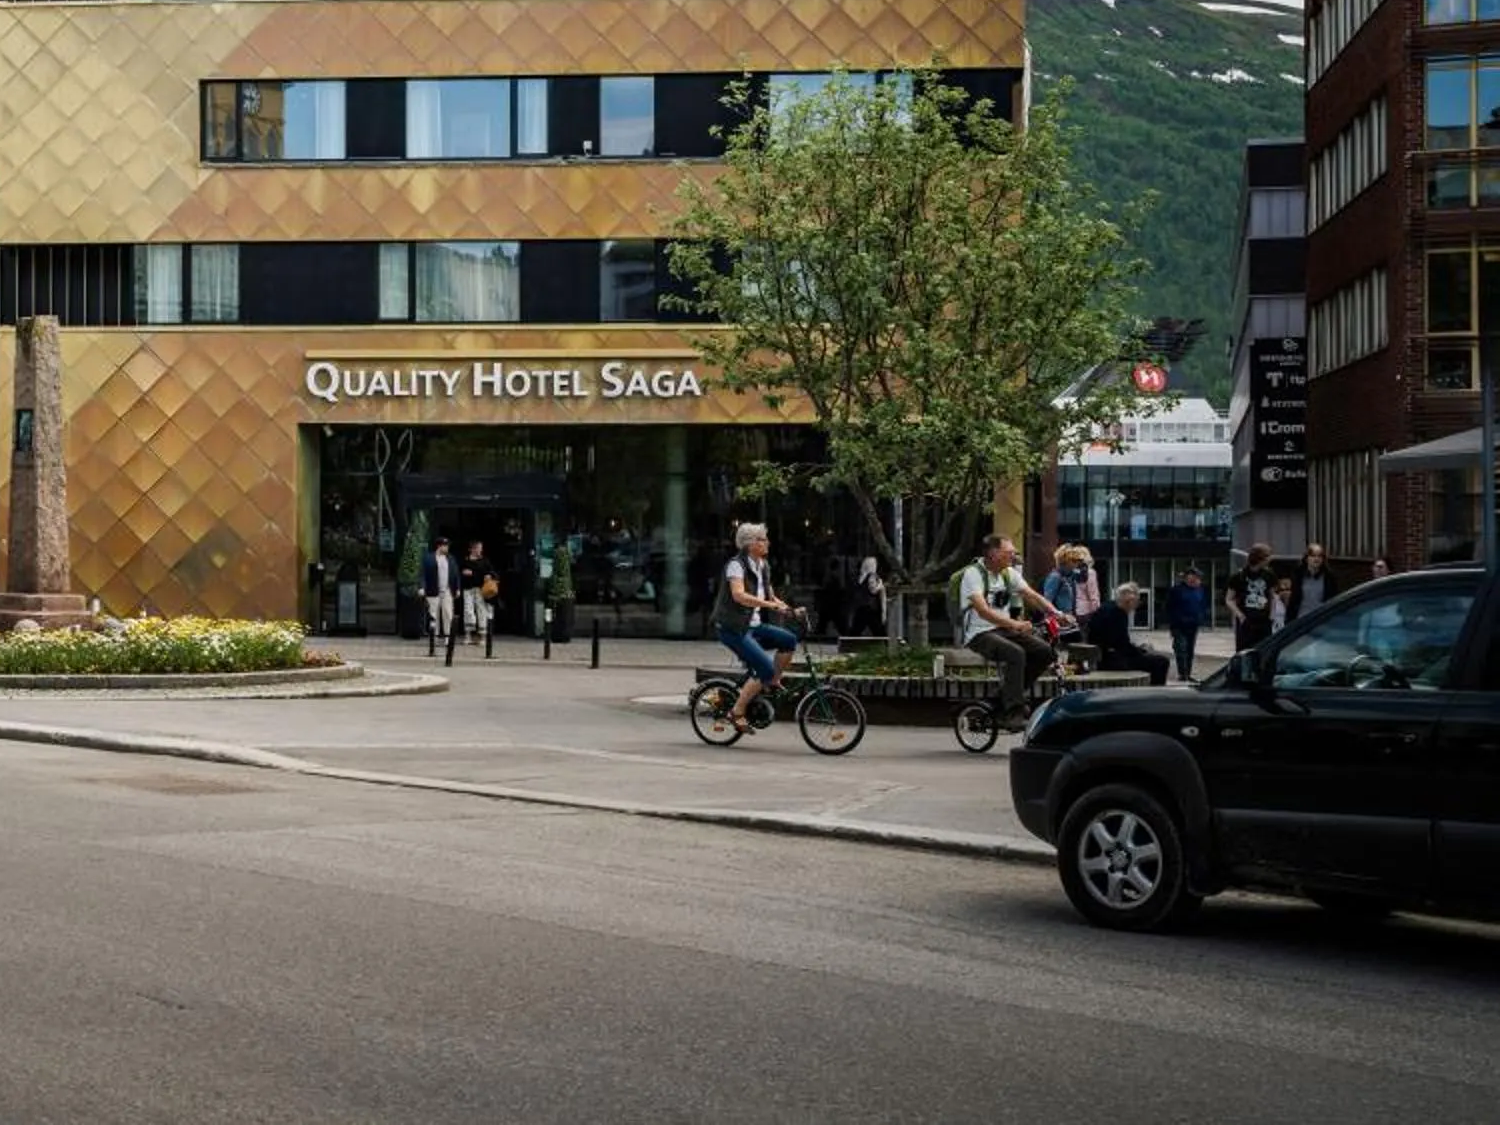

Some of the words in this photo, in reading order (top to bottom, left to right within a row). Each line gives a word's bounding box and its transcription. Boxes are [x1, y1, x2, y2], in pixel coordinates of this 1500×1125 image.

[306, 361, 461, 402] QUALITY
[472, 361, 589, 397] HOTEL
[601, 361, 701, 397] SAGA
